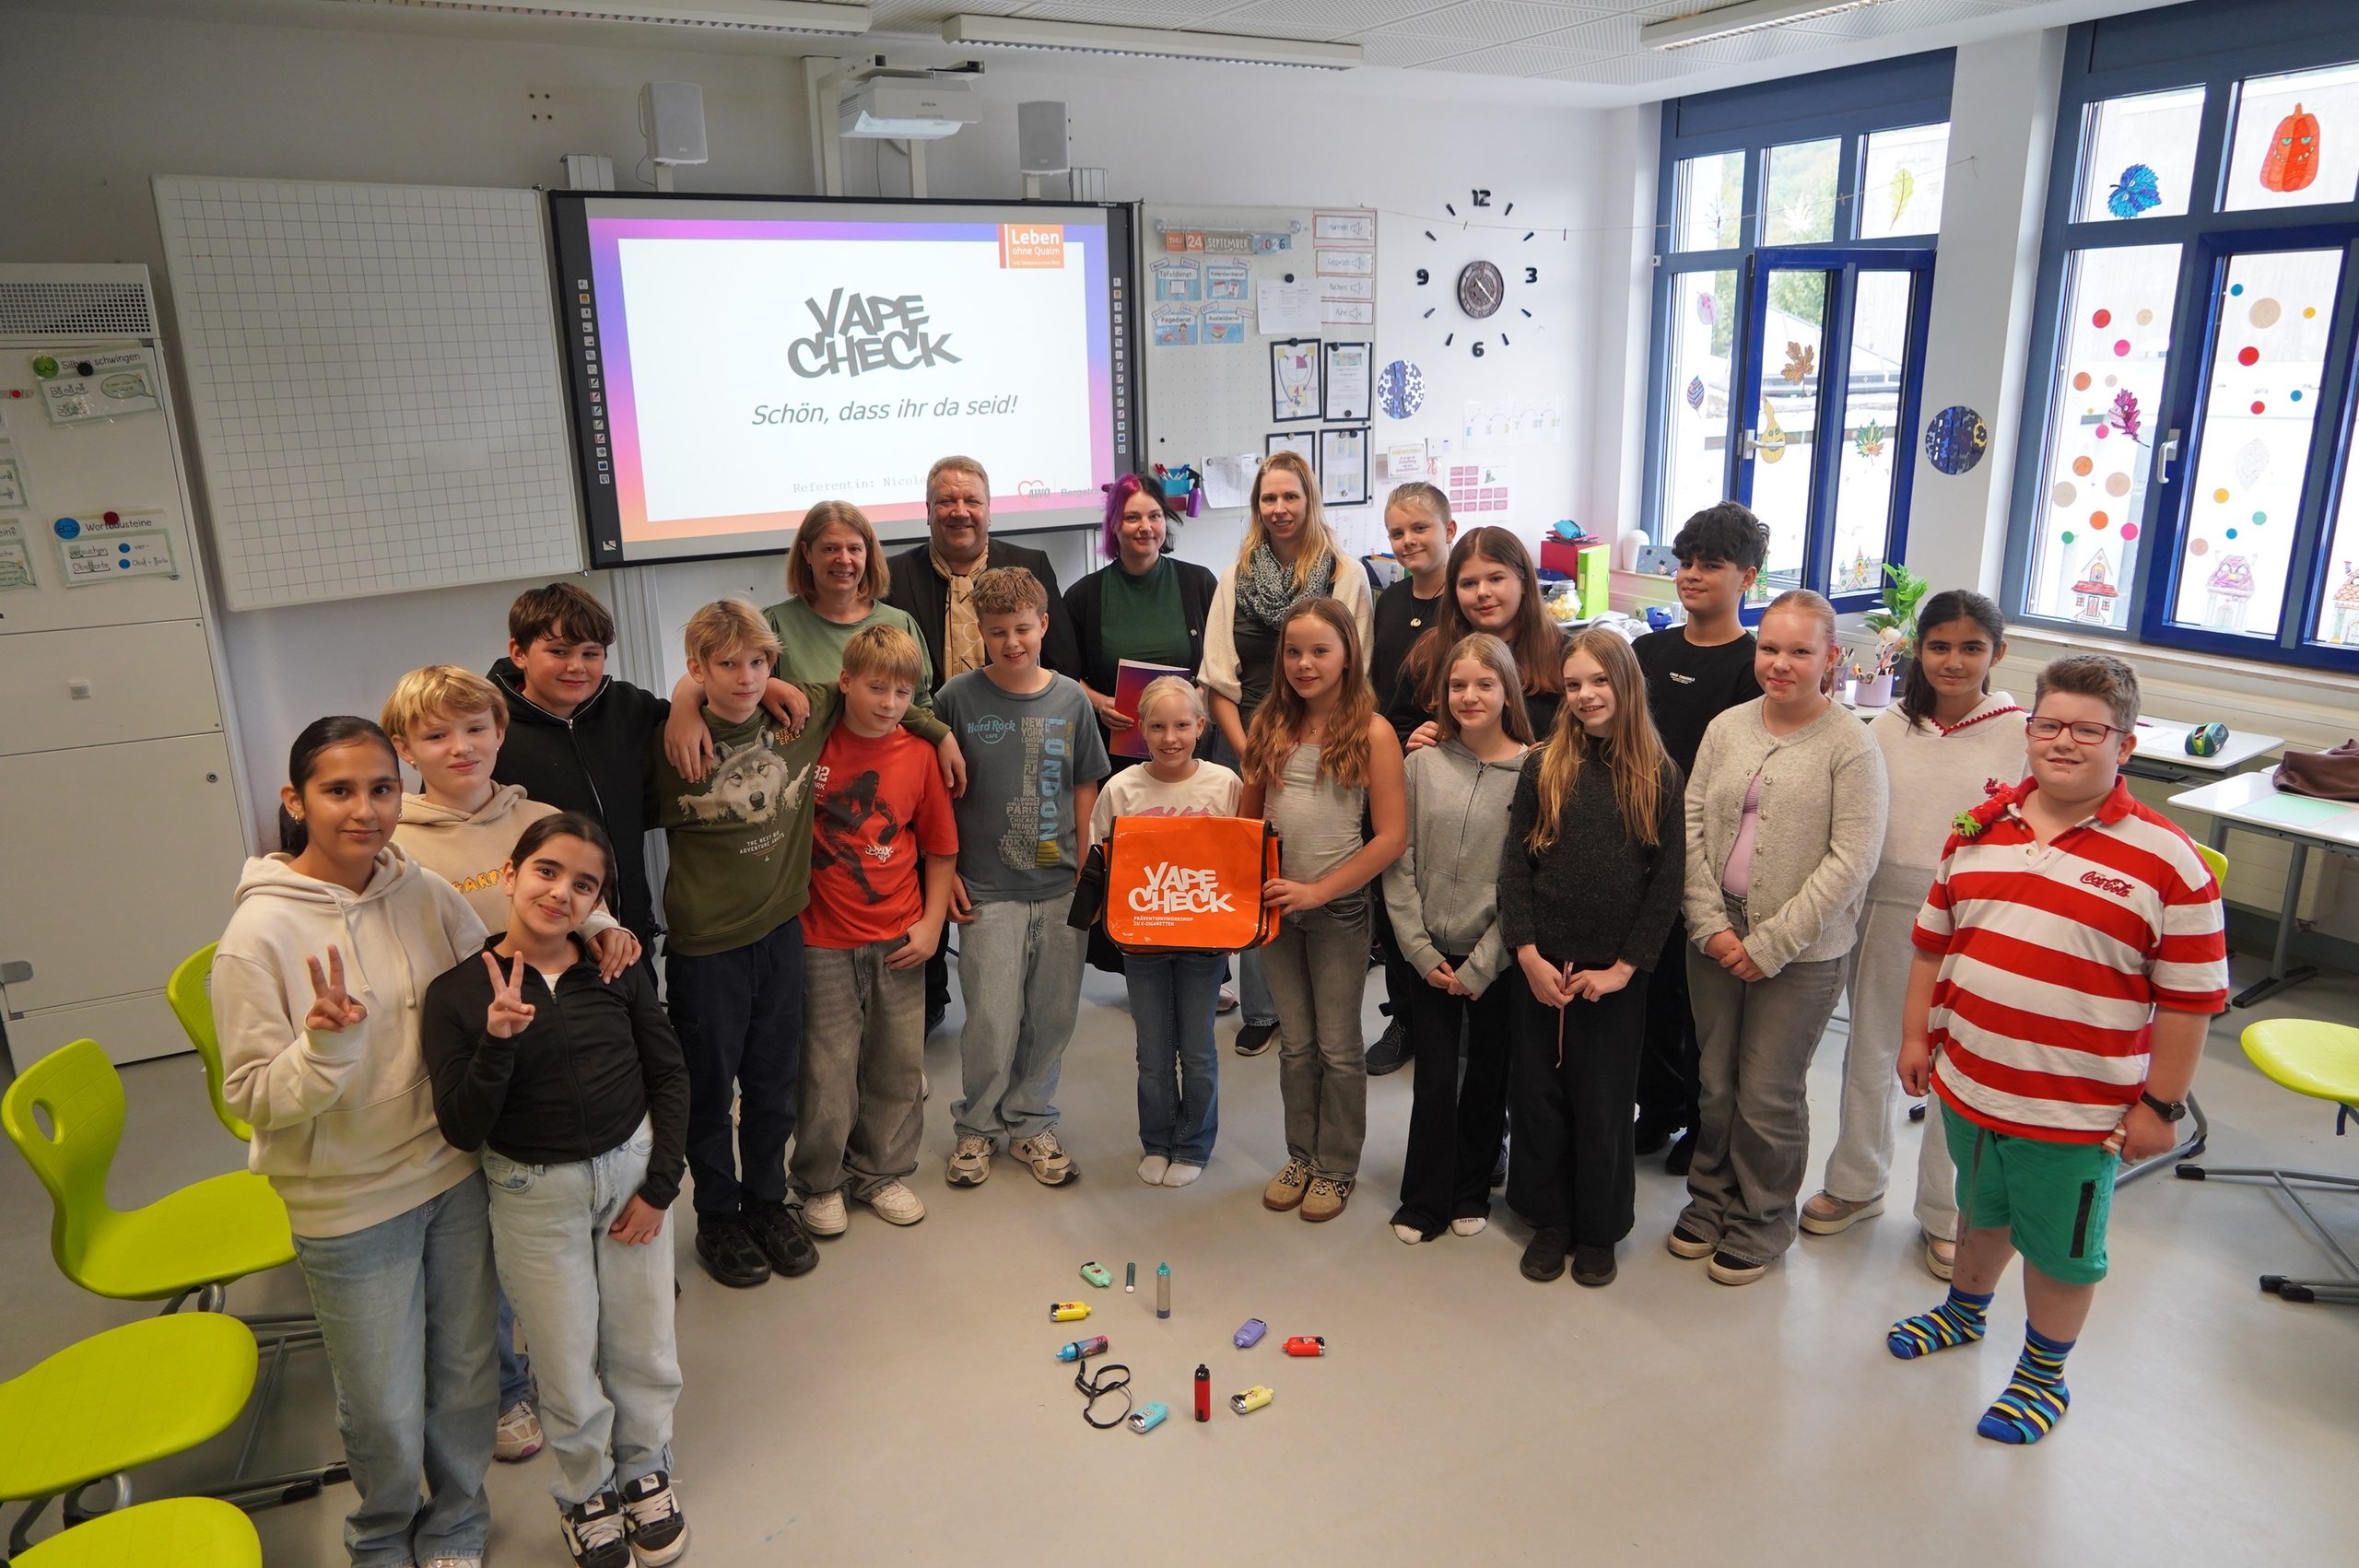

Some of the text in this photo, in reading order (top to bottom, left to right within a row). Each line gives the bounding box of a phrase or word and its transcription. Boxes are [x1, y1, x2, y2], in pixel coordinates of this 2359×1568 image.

[1472, 190, 1491, 207] 12
[1011, 228, 1060, 245] Leben
[1187, 236, 1203, 248] 24
[1207, 237, 1249, 250] SEPTEMBER
[1012, 246, 1061, 258] ohne Qualm
[1416, 269, 1429, 286] 9
[1525, 267, 1538, 283] 3
[804, 287, 930, 338] VAPE
[788, 327, 963, 378] CHECK
[1472, 342, 1485, 357] 6
[62, 353, 140, 370] Silbn schwingen
[752, 395, 1018, 425] Schön, dass ihr da seid!
[793, 476, 926, 494] Referentin: Nicole
[1027, 487, 1051, 498] AWO
[968, 720, 1016, 733] Hard Rock
[1021, 717, 1044, 728] NEW
[1021, 728, 1044, 738] YORK
[1039, 717, 1066, 840] LONDON
[1006, 806, 1039, 814] PARIS
[759, 834, 771, 843] NEXT
[999, 839, 1038, 848] TOKYO
[739, 841, 770, 854] ADVENTURE
[1144, 861, 1219, 891] VAPE
[1128, 884, 1237, 913] CHECK
